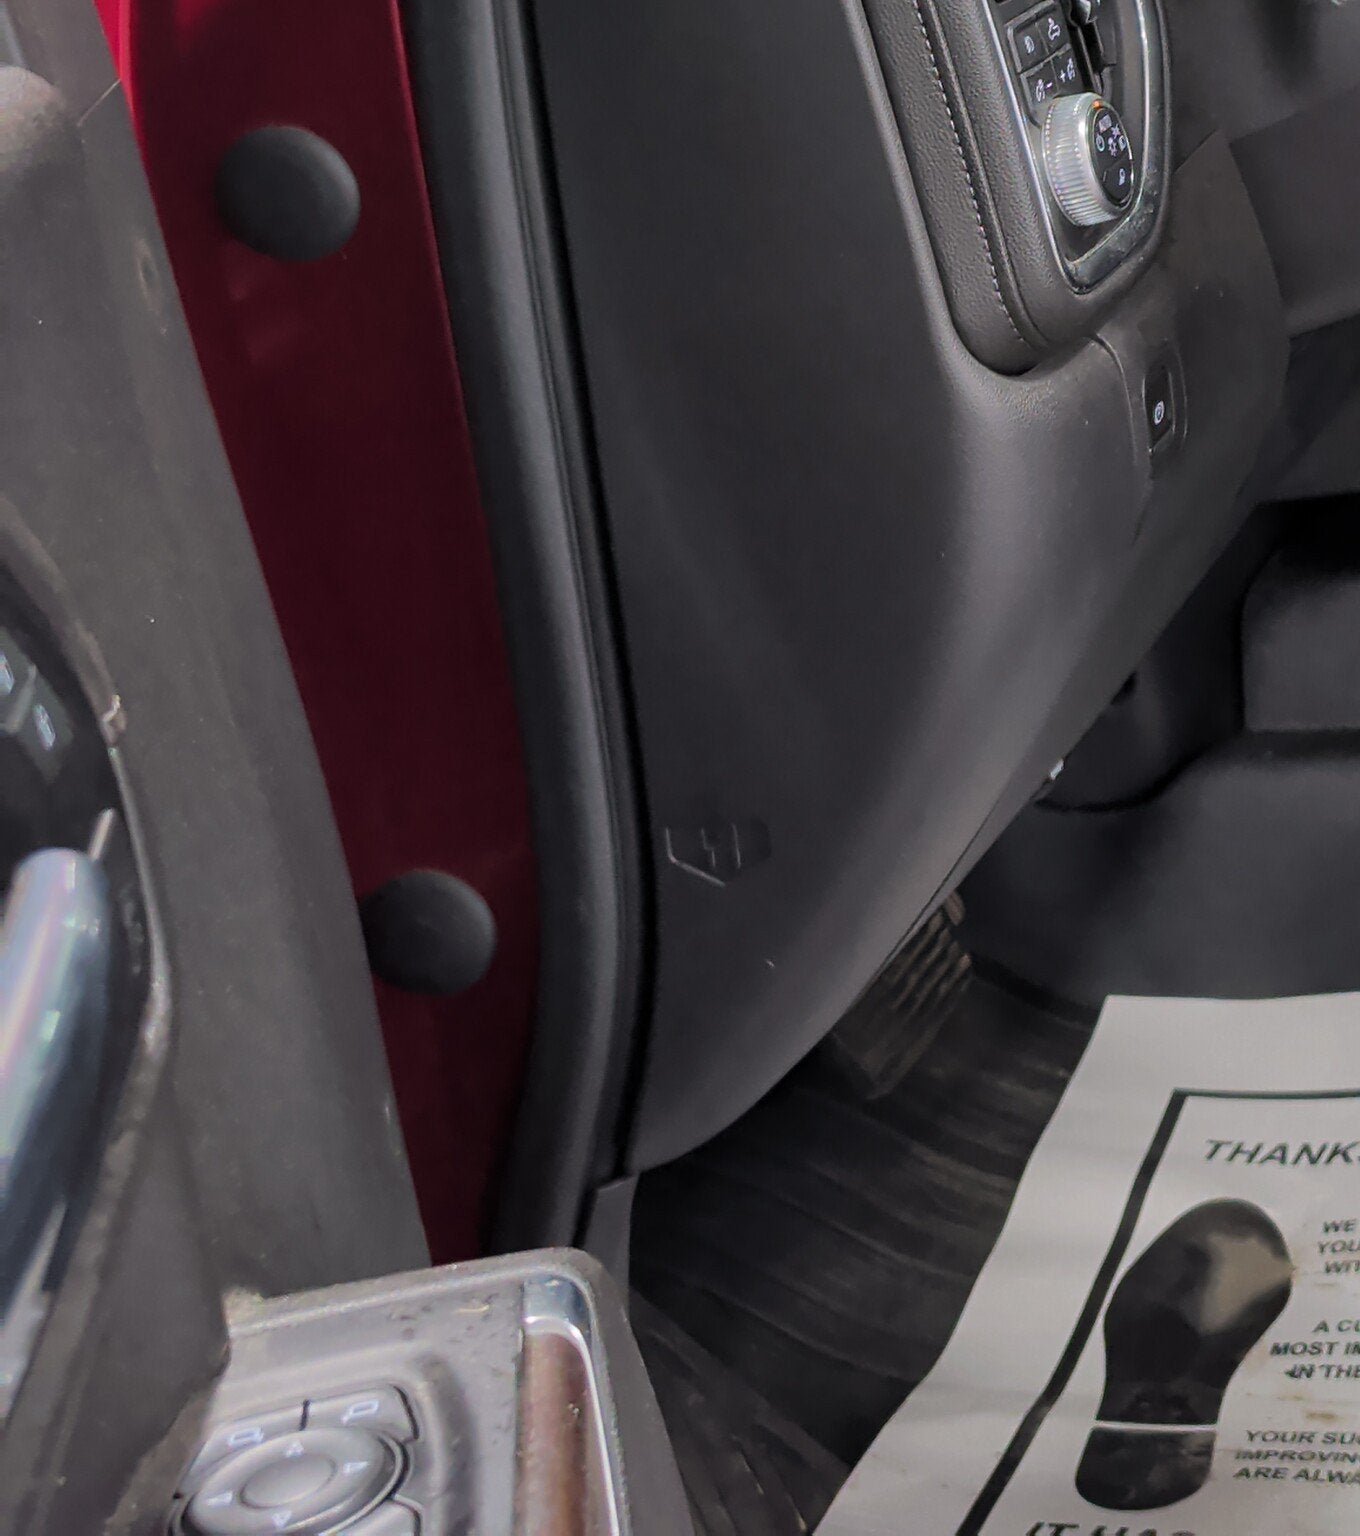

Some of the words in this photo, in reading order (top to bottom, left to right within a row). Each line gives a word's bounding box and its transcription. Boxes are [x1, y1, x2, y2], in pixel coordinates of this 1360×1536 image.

[1322, 1217, 1356, 1234] WE
[1313, 1320, 1330, 1334] A
[1270, 1341, 1339, 1357] MOST
[1246, 1429, 1315, 1444] YOUR
[1233, 1467, 1289, 1480] ARE
